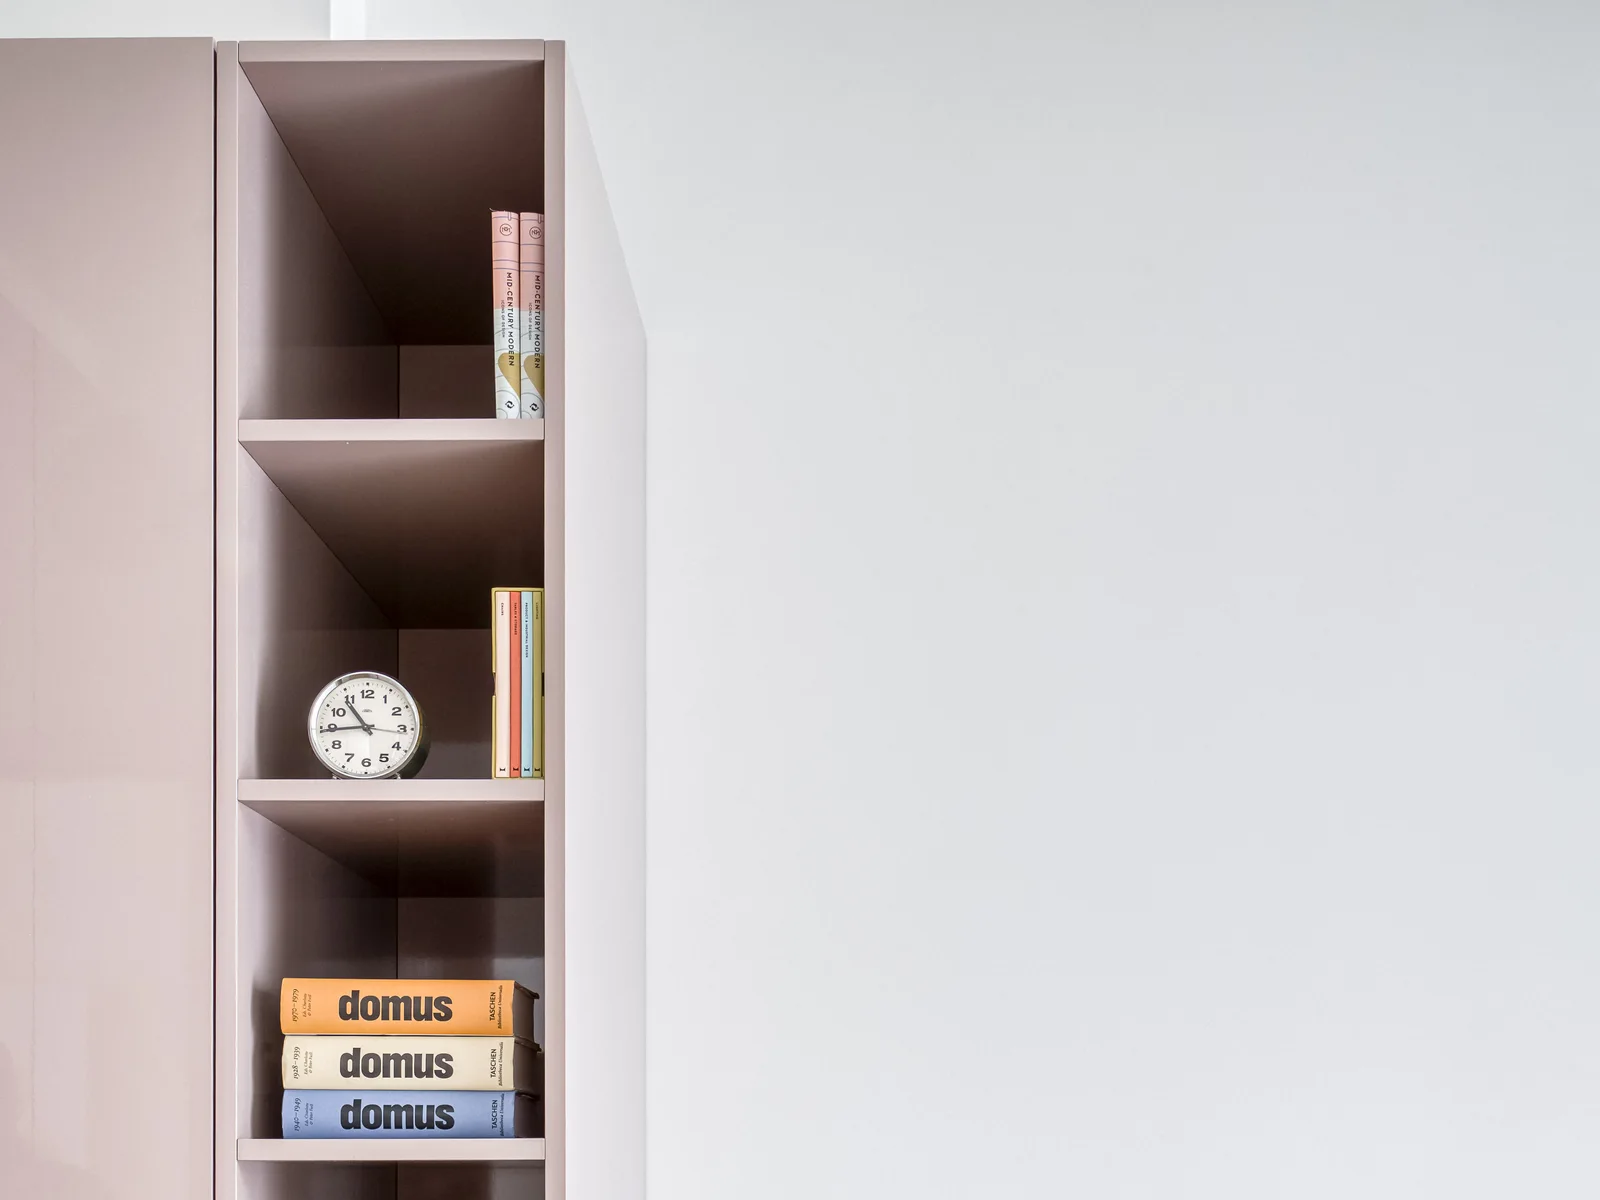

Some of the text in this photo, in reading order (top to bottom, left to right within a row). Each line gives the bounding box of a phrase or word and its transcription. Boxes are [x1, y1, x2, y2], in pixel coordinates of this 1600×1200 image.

[360, 690, 374, 699] 12
[344, 695, 354, 704] 11
[383, 695, 387, 704] 1
[331, 708, 346, 717] 10
[392, 707, 402, 716] 2
[328, 723, 337, 732] 9
[397, 725, 407, 733] 3
[332, 740, 342, 749] 8
[392, 742, 401, 751] 4
[345, 753, 354, 762] 7
[379, 754, 389, 762] 5
[361, 758, 371, 767] 6
[338, 990, 452, 1022] domus
[340, 1048, 453, 1079] domus
[340, 1099, 454, 1130] domus
